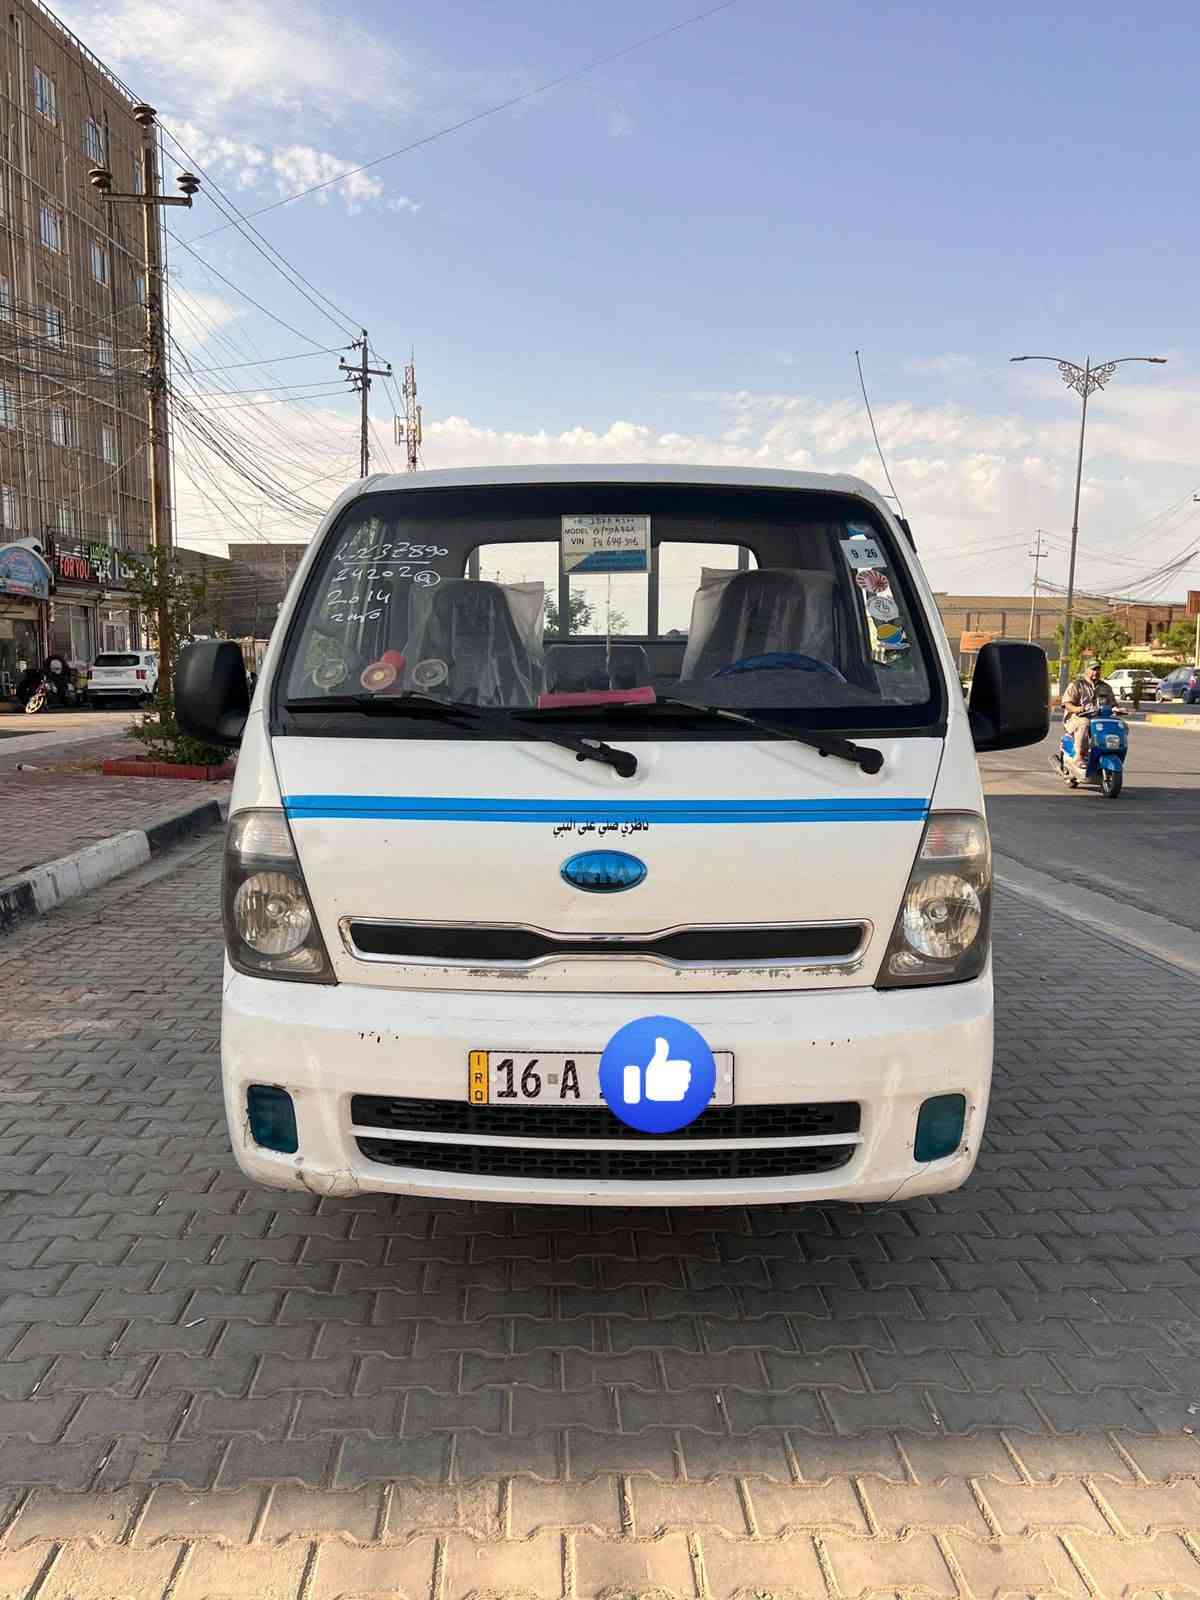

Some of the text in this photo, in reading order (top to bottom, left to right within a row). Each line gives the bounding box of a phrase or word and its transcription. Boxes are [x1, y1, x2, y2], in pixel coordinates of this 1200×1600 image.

[564, 527, 589, 535] MODEL
[864, 547, 878, 558] 26
[327, 589, 391, 605] 2014
[496, 1058, 542, 1099] 16
[559, 1059, 581, 1099] A
